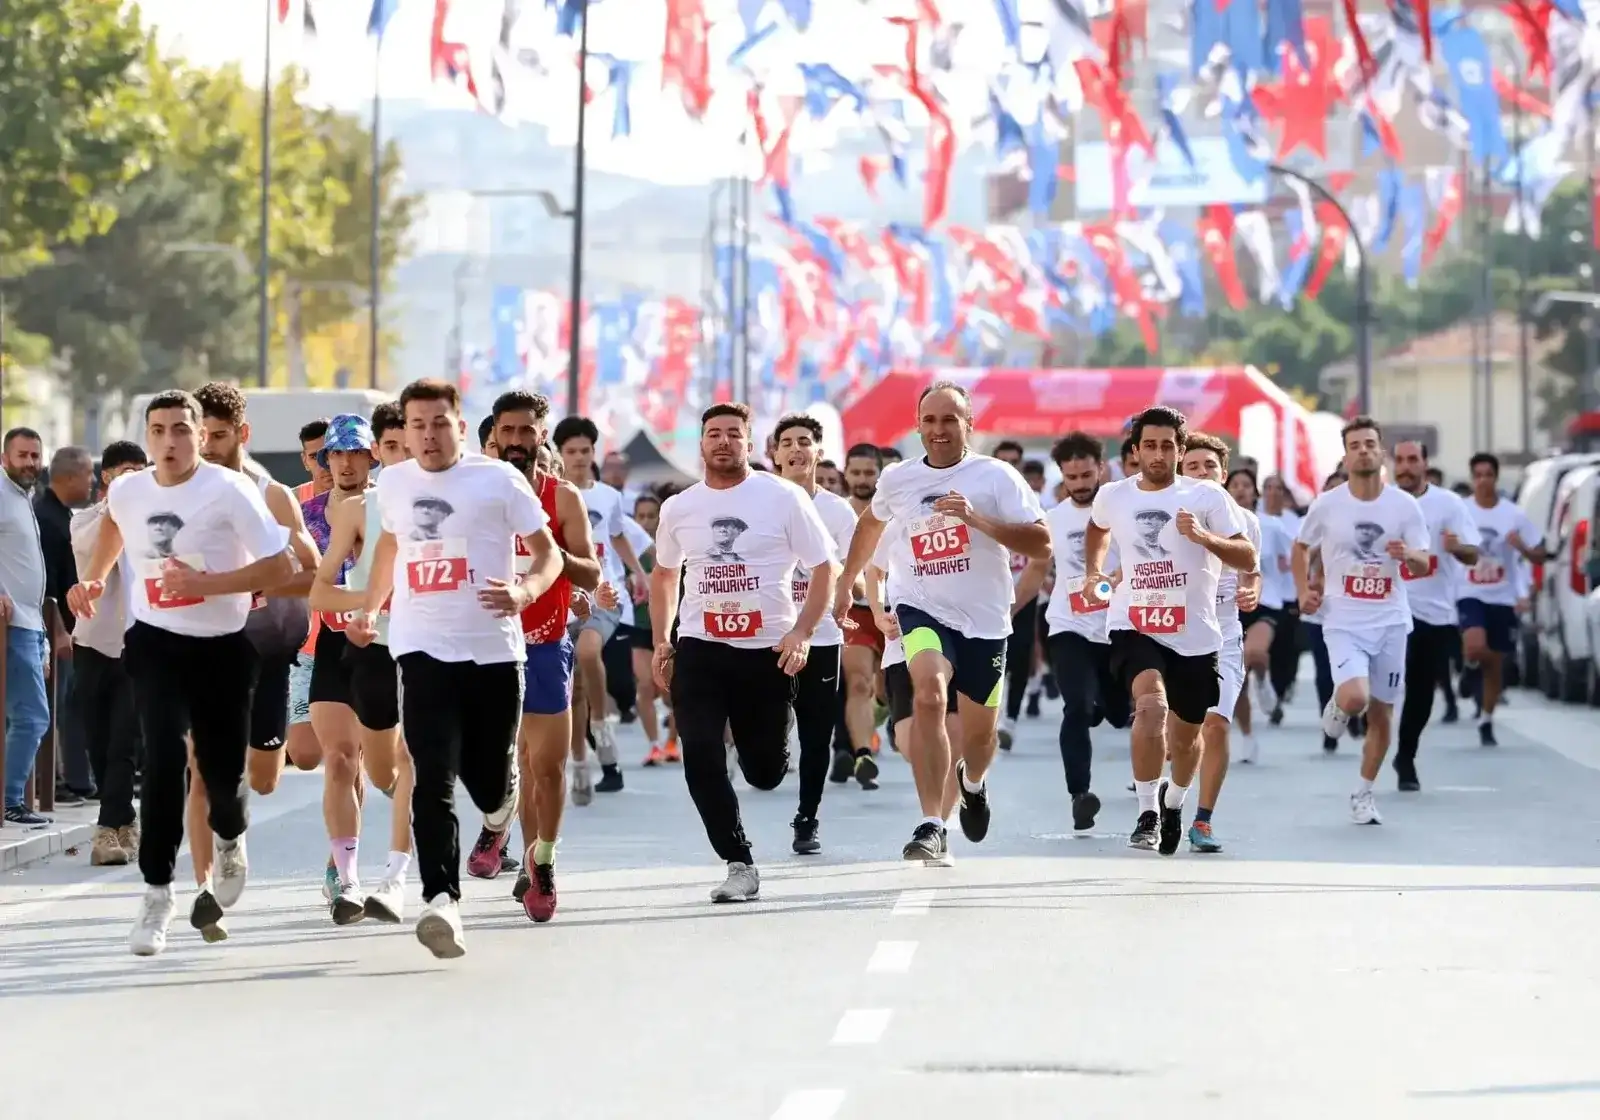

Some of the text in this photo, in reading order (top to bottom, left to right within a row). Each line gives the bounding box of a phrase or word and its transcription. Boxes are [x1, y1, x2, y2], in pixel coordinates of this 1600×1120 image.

[919, 528, 960, 555] 205
[415, 560, 453, 586] 172
[1352, 578, 1385, 595] 088
[714, 614, 750, 632] 169
[1138, 607, 1175, 628] 146
[1389, 671, 1400, 688] 11
